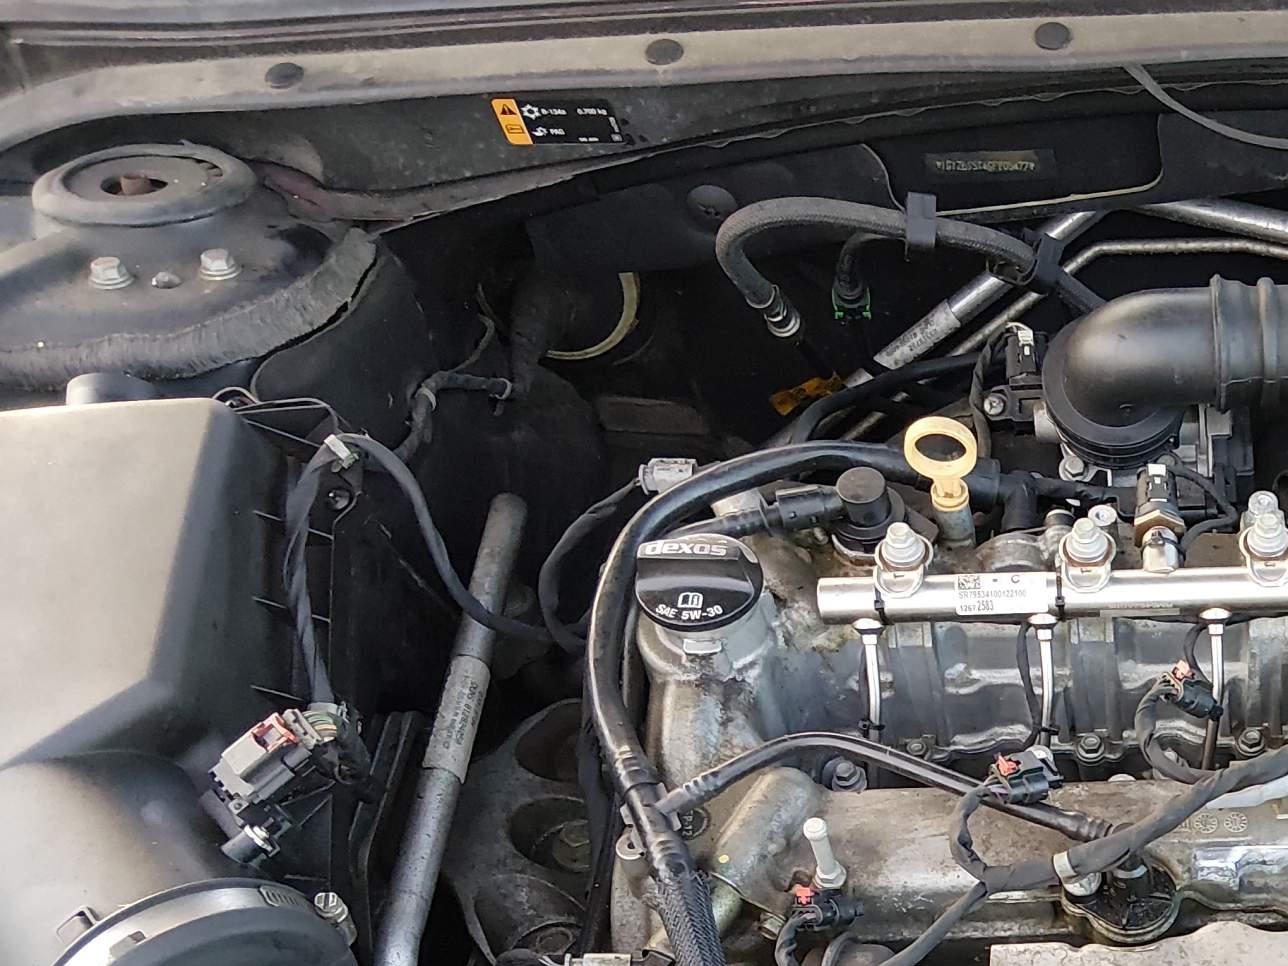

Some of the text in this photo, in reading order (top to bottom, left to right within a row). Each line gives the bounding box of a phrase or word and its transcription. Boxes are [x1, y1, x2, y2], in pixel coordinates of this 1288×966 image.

[645, 541, 728, 556] dexos
[656, 604, 724, 620] SAE 5W-30
